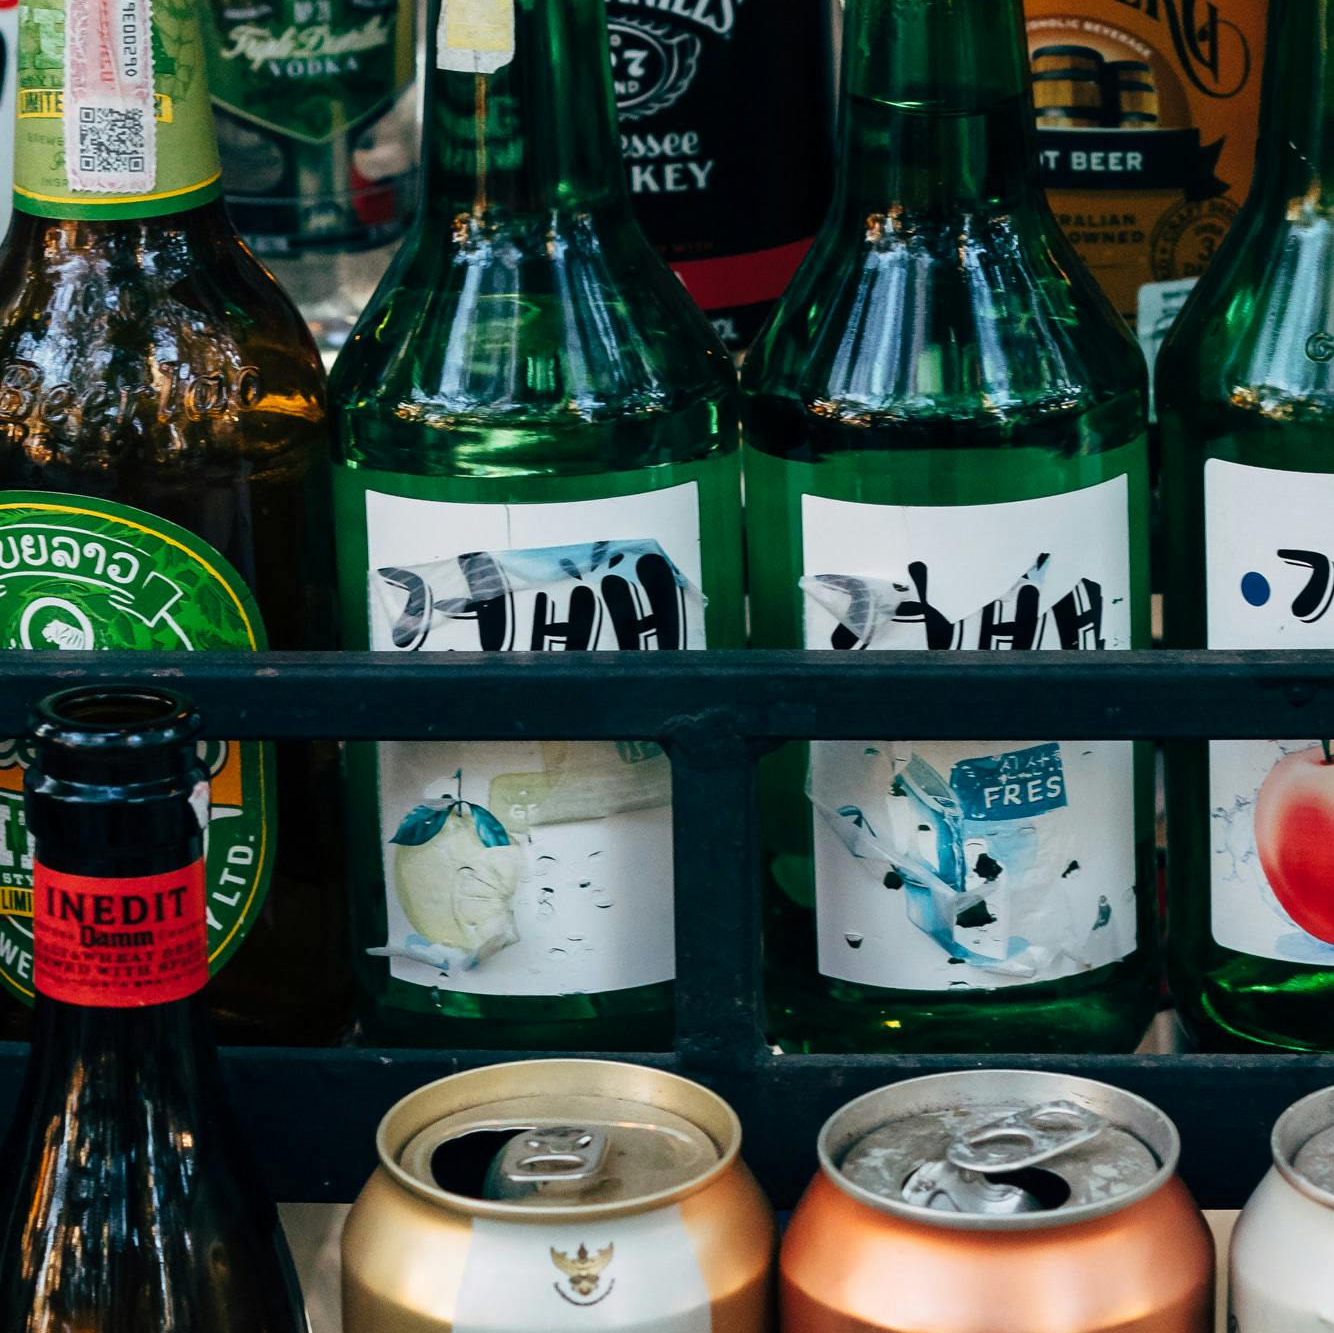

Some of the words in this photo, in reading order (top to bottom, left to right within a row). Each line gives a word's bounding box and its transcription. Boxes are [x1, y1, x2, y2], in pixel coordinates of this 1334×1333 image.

[20, 89, 65, 115] LIMITE
[621, 130, 700, 158] essee
[1072, 150, 1144, 171] BEER
[631, 160, 714, 194] KEY
[1059, 212, 1137, 229] RALIAN
[212, 834, 256, 907] LTD.
[47, 886, 188, 927] INEDIT
[80, 925, 155, 950] Damm
